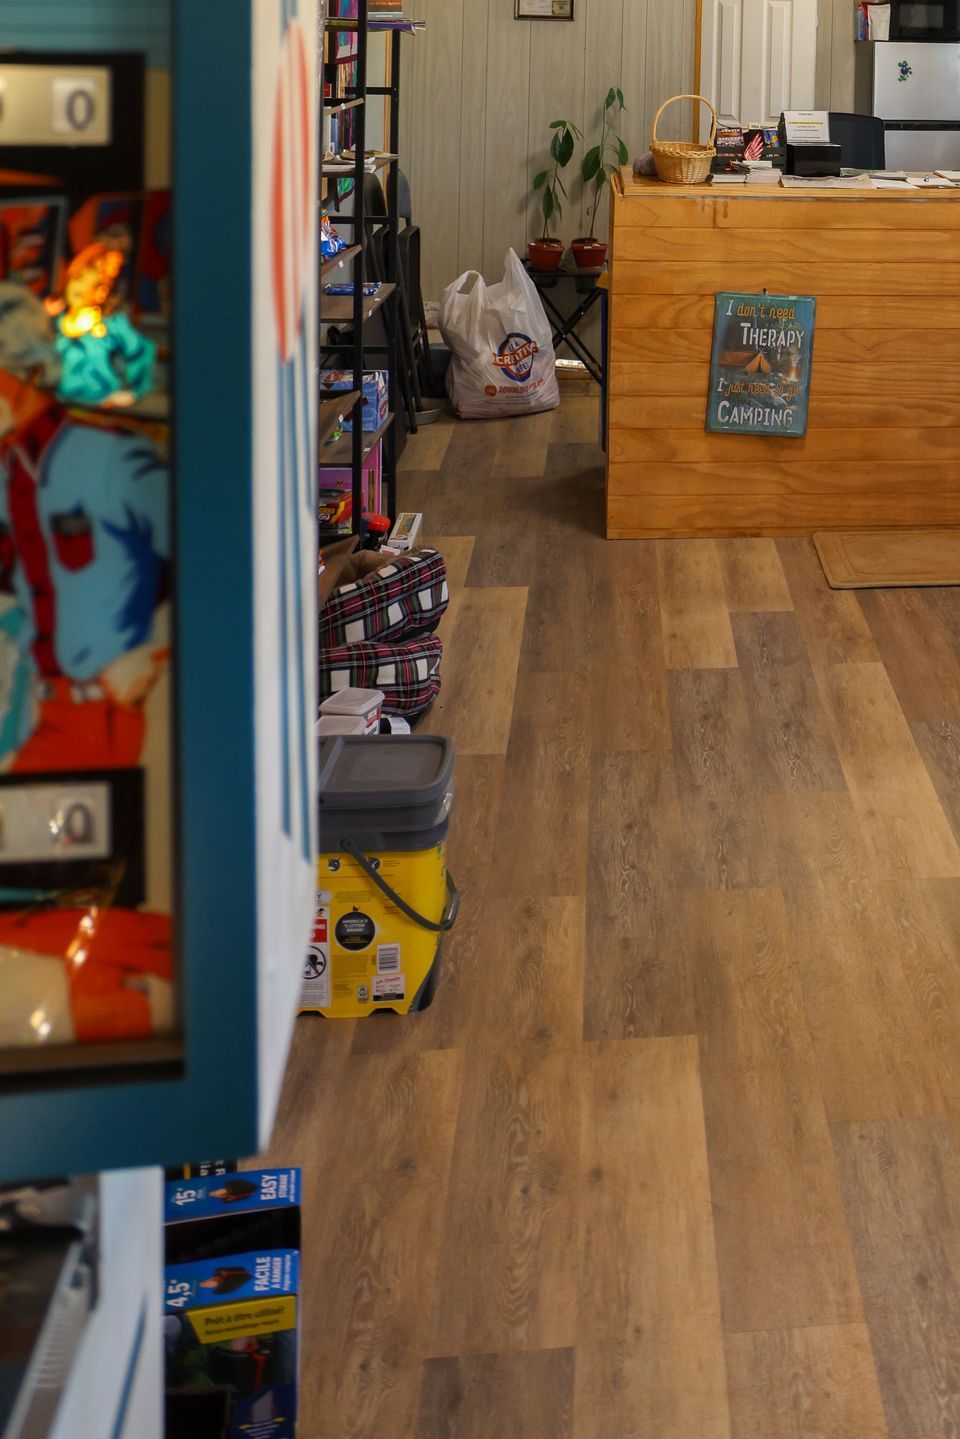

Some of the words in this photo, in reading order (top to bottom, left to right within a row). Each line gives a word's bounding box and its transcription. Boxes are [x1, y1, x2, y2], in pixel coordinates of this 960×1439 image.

[726, 300, 734, 316] I
[736, 303, 765, 318] don't
[769, 305, 797, 320] need
[740, 322, 804, 348] THERAPY
[717, 377, 725, 392] I
[725, 380, 745, 397] just
[717, 400, 793, 427] CAMPING
[261, 1175, 277, 1200] EASY
[278, 1174, 288, 1198] STORAGE
[254, 1257, 271, 1291] FACILE
[272, 1257, 282, 1281] RANGER
